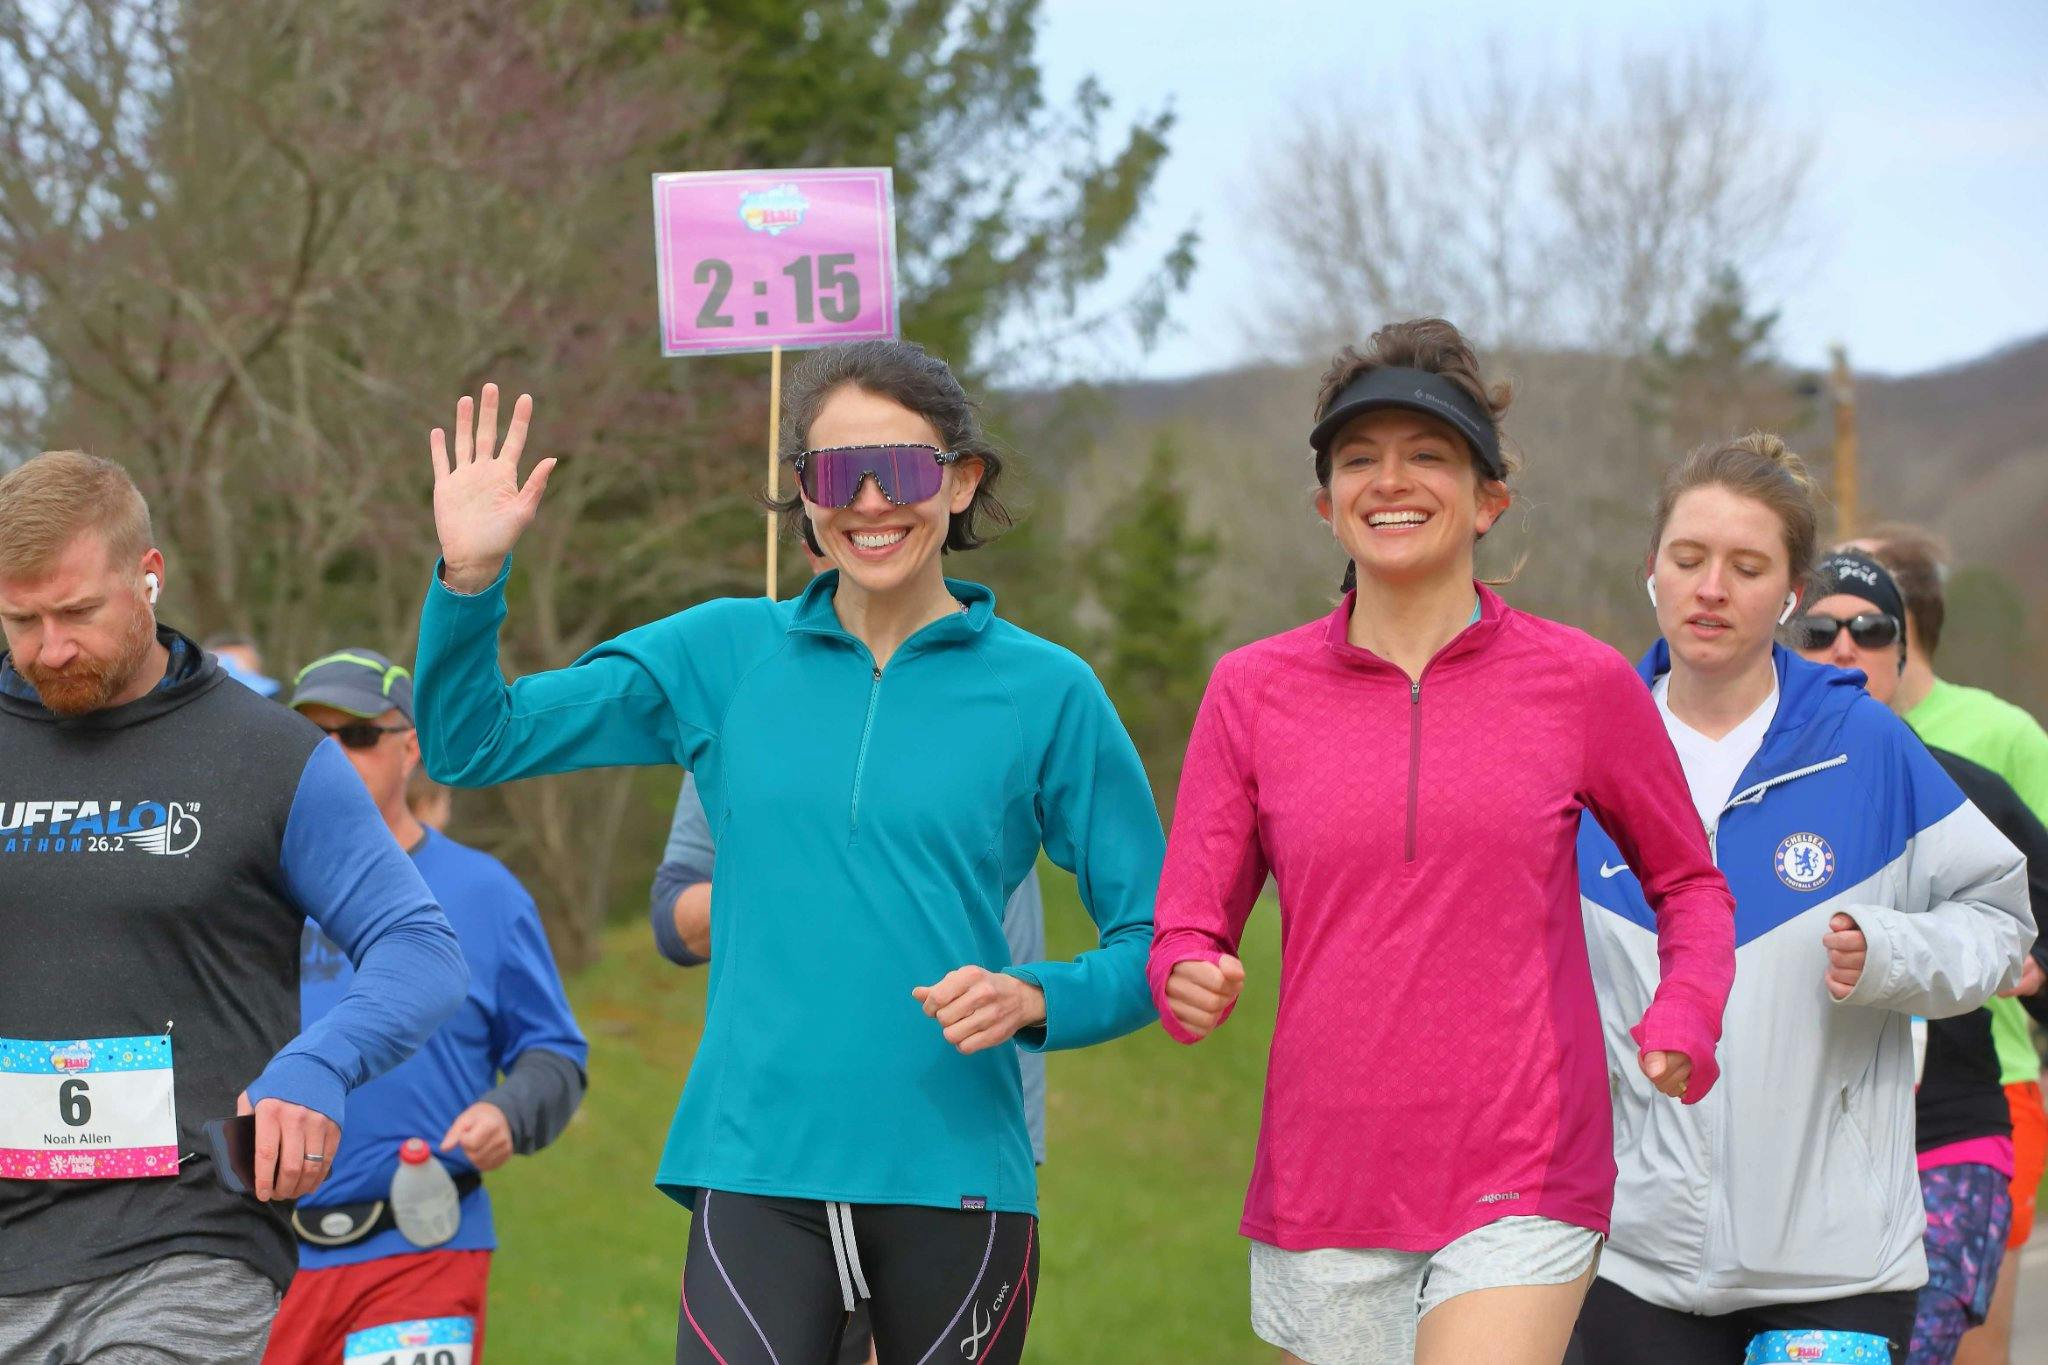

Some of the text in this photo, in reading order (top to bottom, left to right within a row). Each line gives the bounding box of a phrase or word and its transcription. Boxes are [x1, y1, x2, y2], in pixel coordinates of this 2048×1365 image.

[88, 836, 125, 852] 26.2
[1784, 834, 1824, 848] CHELSEA
[59, 1078, 92, 1127] 6
[44, 1133, 112, 1144] Noah Allen
